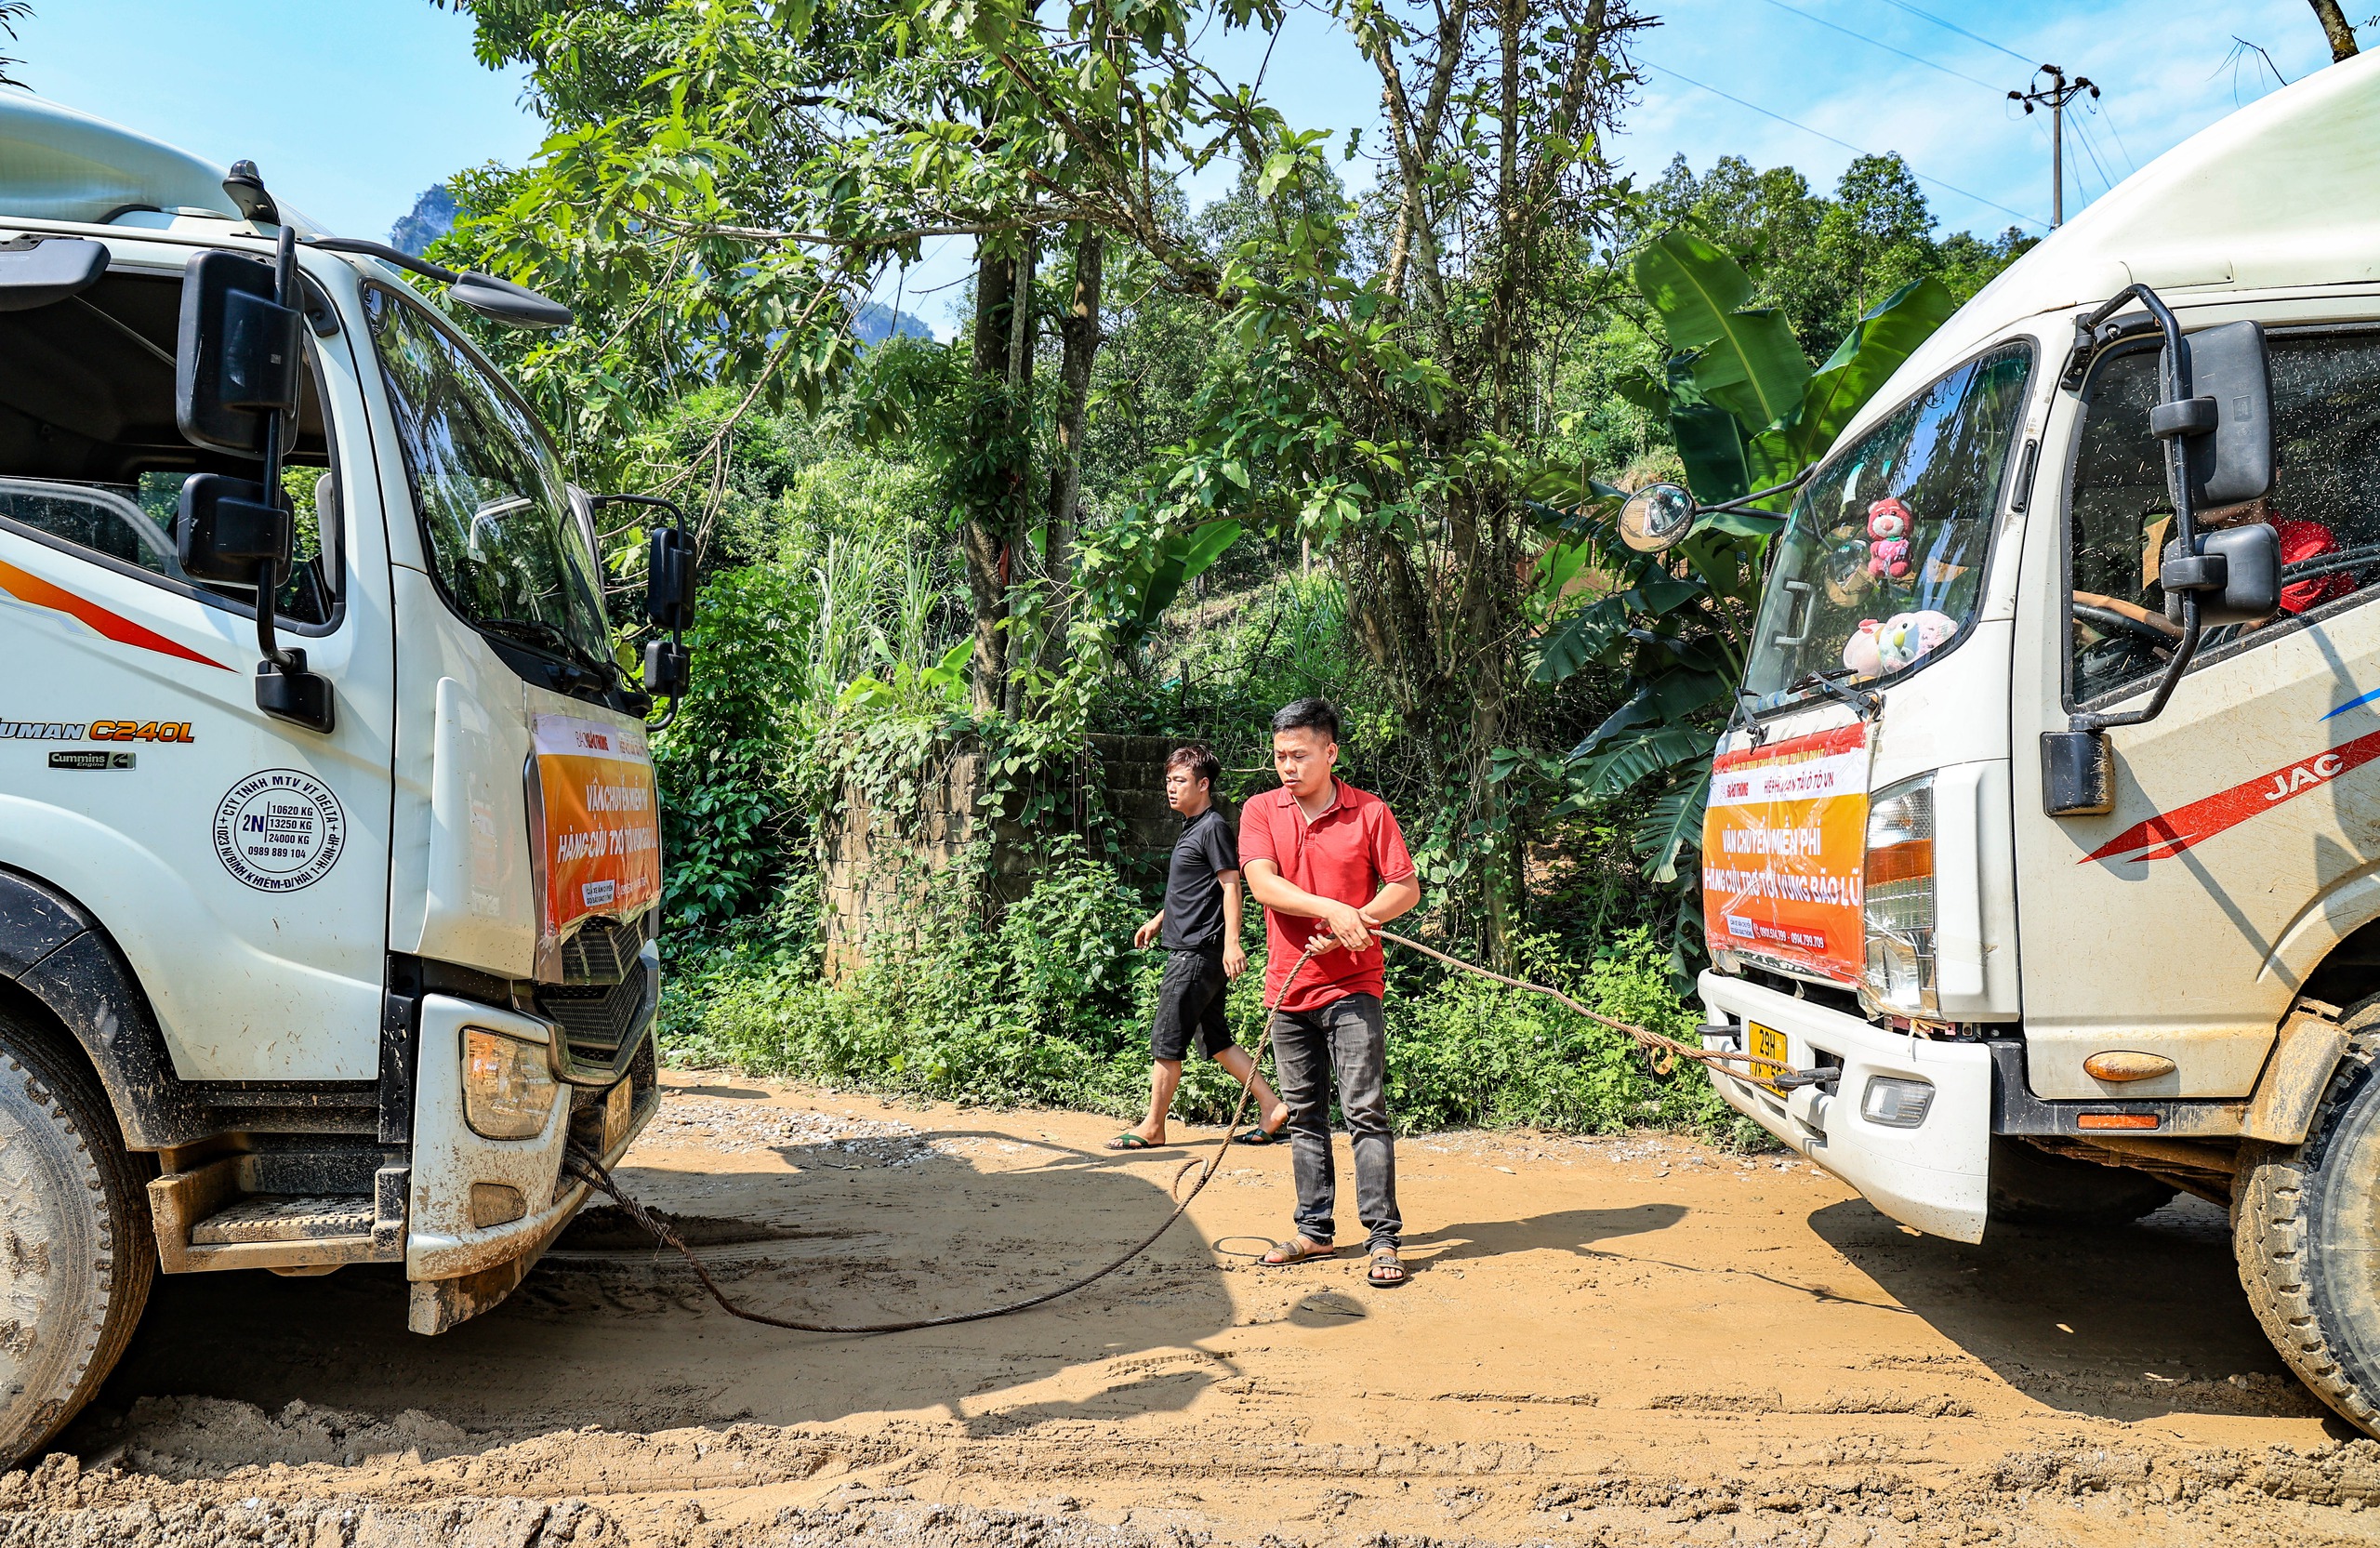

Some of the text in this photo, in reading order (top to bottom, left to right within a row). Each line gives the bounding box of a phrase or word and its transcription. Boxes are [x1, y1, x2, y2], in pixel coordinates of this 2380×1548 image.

[0, 720, 195, 743] UMAN C240L
[51, 752, 105, 763] Cummins
[1813, 769, 1823, 789] TÔ
[1824, 771, 1834, 788] VN
[2264, 753, 2343, 800] JAC
[222, 775, 339, 824] CTY TNHH MTV VT DELTA
[586, 777, 605, 820] VẬN
[271, 804, 313, 816] 10620 KG
[243, 814, 265, 833] 2N
[270, 819, 312, 830] 13250 KG
[217, 825, 230, 846] 1023
[269, 833, 310, 845] 24000 KG
[558, 825, 589, 864] HÀNG
[1722, 823, 1737, 861] VẬN
[1799, 818, 1821, 856] PHÍ
[248, 846, 306, 858] 0989 889 104
[1704, 861, 1726, 893] HÀNG
[1777, 866, 1811, 903] VÙNG
[1810, 867, 1839, 906] BÃO
[1840, 867, 1861, 907] LŨ
[1791, 933, 1825, 949] 0914.799.709
[1759, 1028, 1776, 1060] 29H
